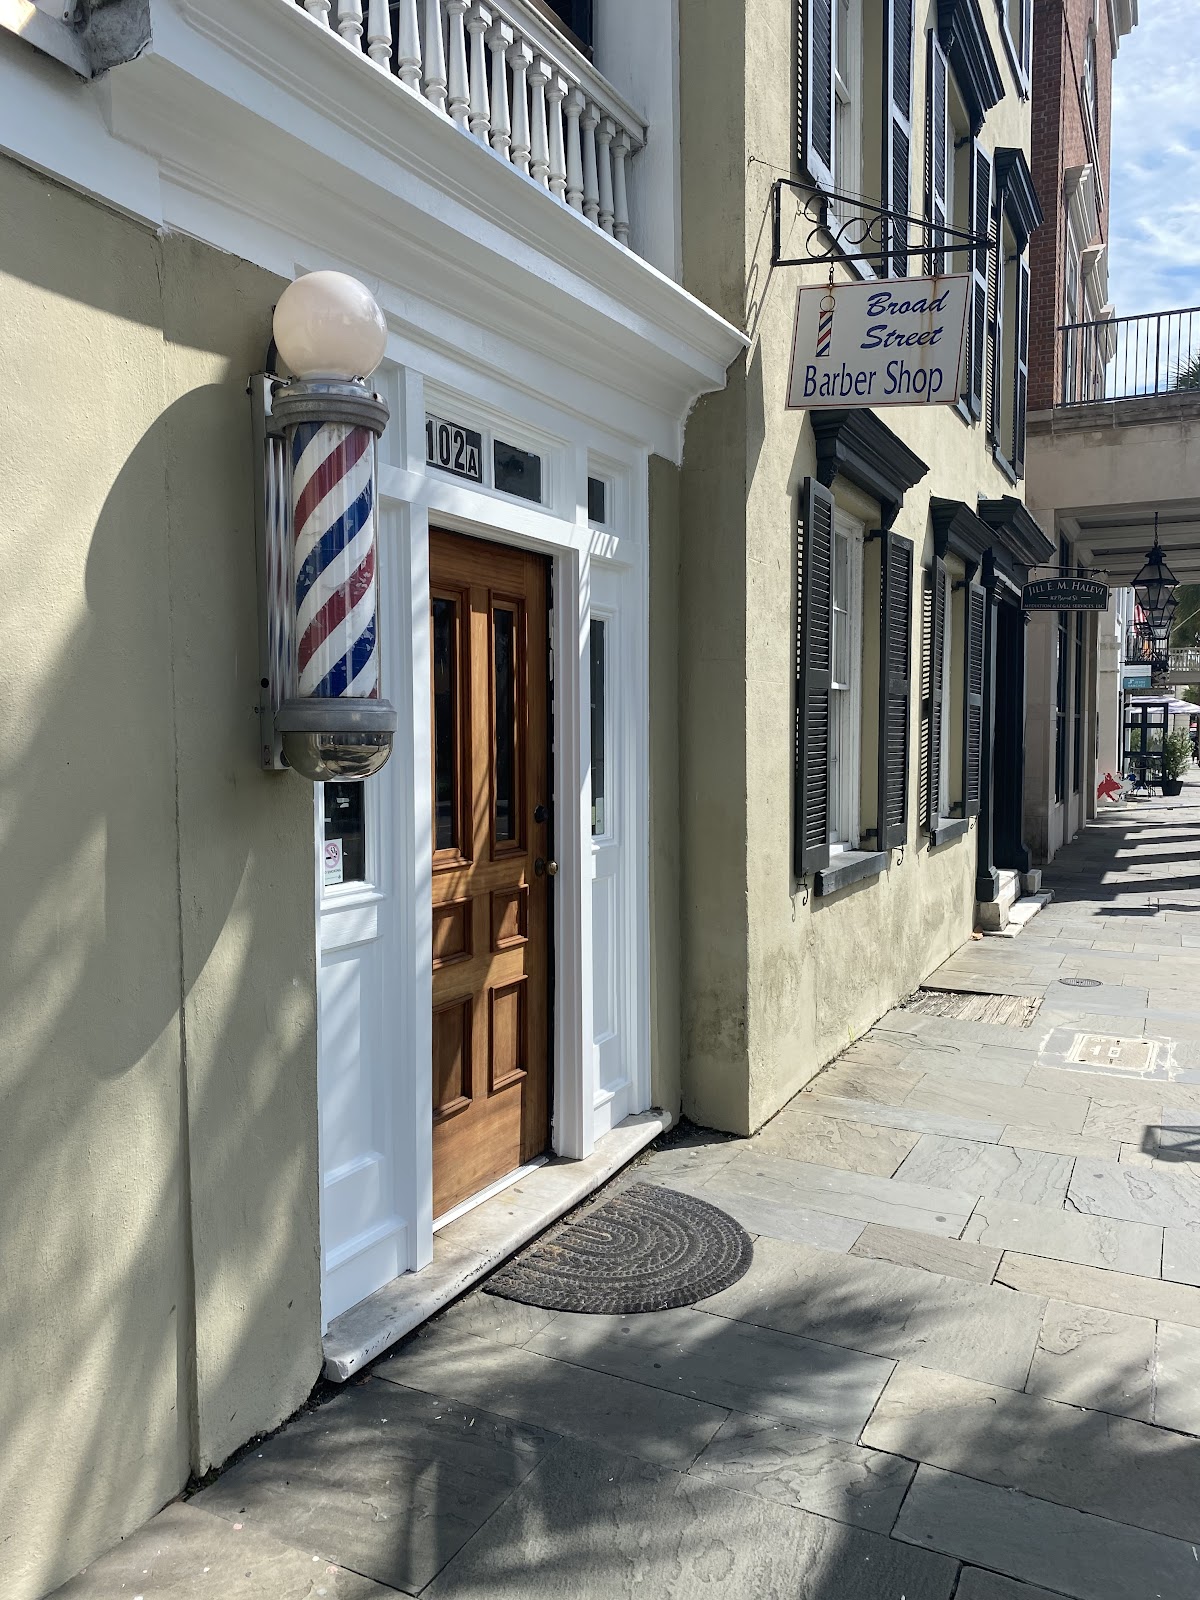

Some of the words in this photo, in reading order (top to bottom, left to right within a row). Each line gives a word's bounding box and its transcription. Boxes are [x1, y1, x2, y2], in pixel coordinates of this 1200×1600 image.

[866, 290, 950, 317] Broad
[860, 324, 944, 349] Street
[803, 362, 877, 398] Barber
[884, 359, 943, 403] Shop
[427, 419, 478, 475] 102A
[1028, 586, 1045, 596] JILL
[1057, 581, 1068, 590] M.
[1072, 581, 1104, 595] HALEVI
